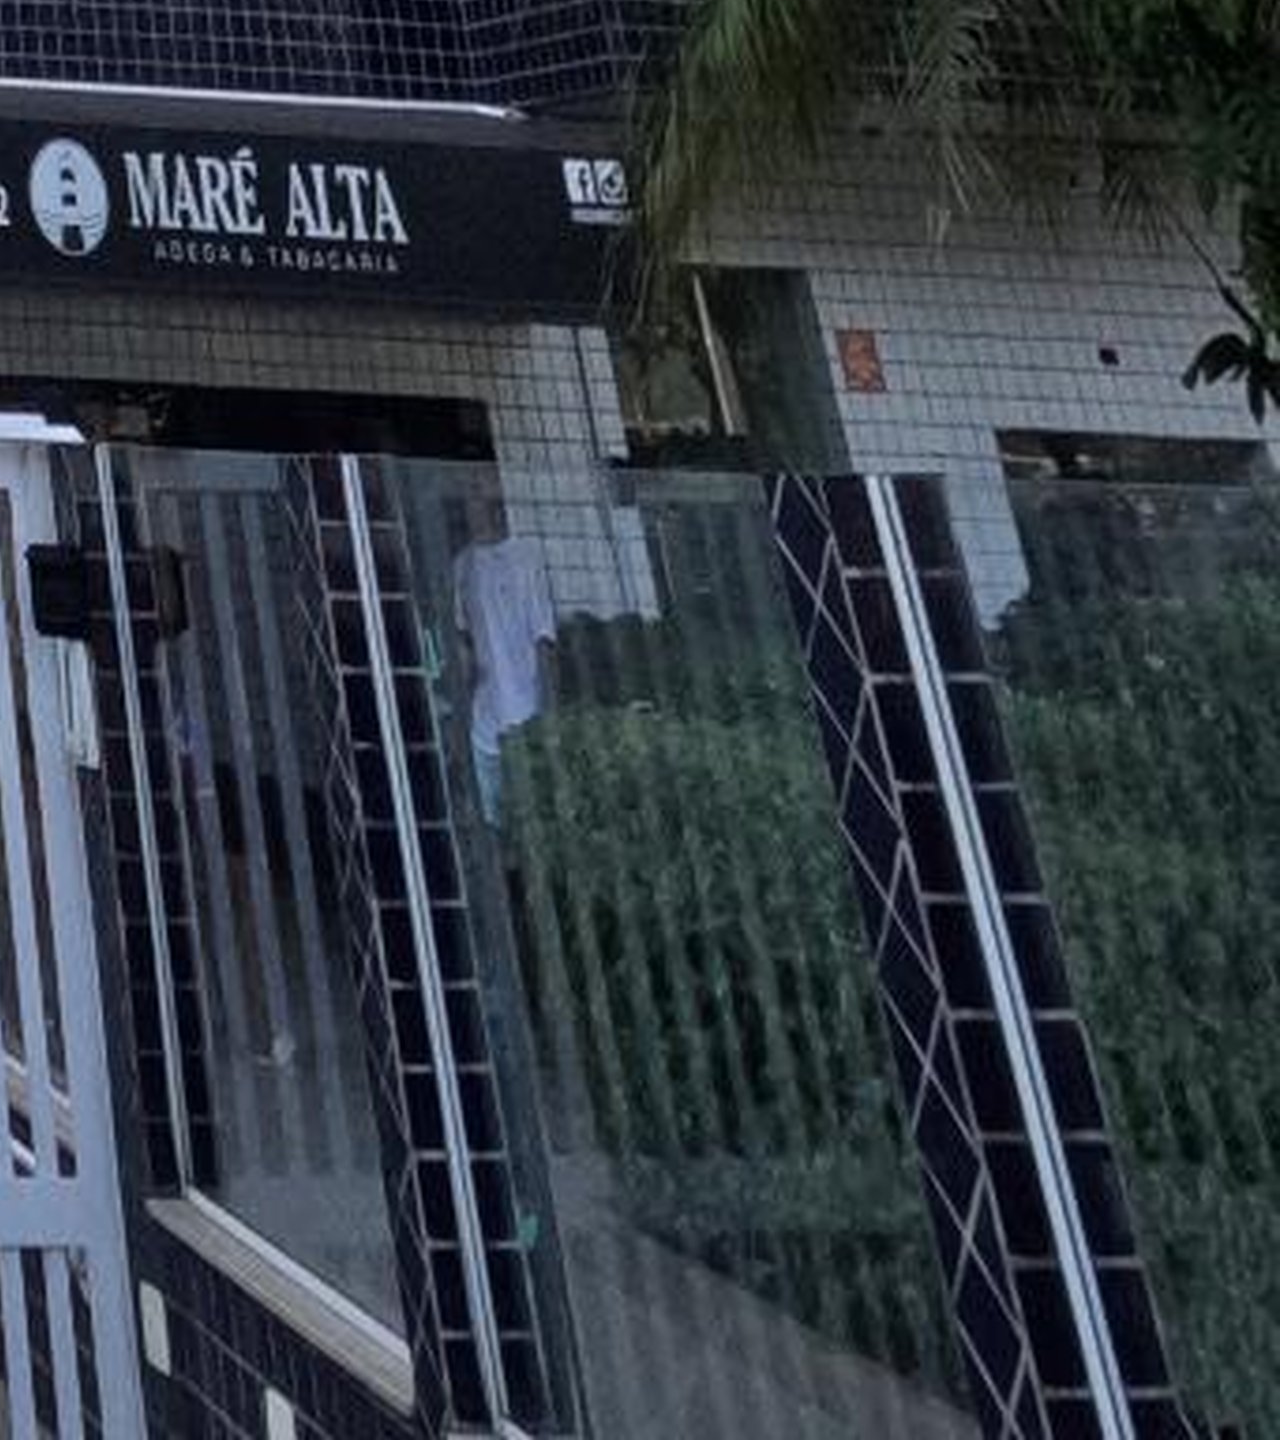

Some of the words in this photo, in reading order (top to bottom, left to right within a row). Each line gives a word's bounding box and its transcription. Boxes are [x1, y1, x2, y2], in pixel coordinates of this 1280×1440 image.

[122, 146, 266, 235] MARÉ
[285, 162, 410, 244] ALTA
[153, 240, 232, 264] ADEGA
[267, 246, 399, 273] TABACARIA
